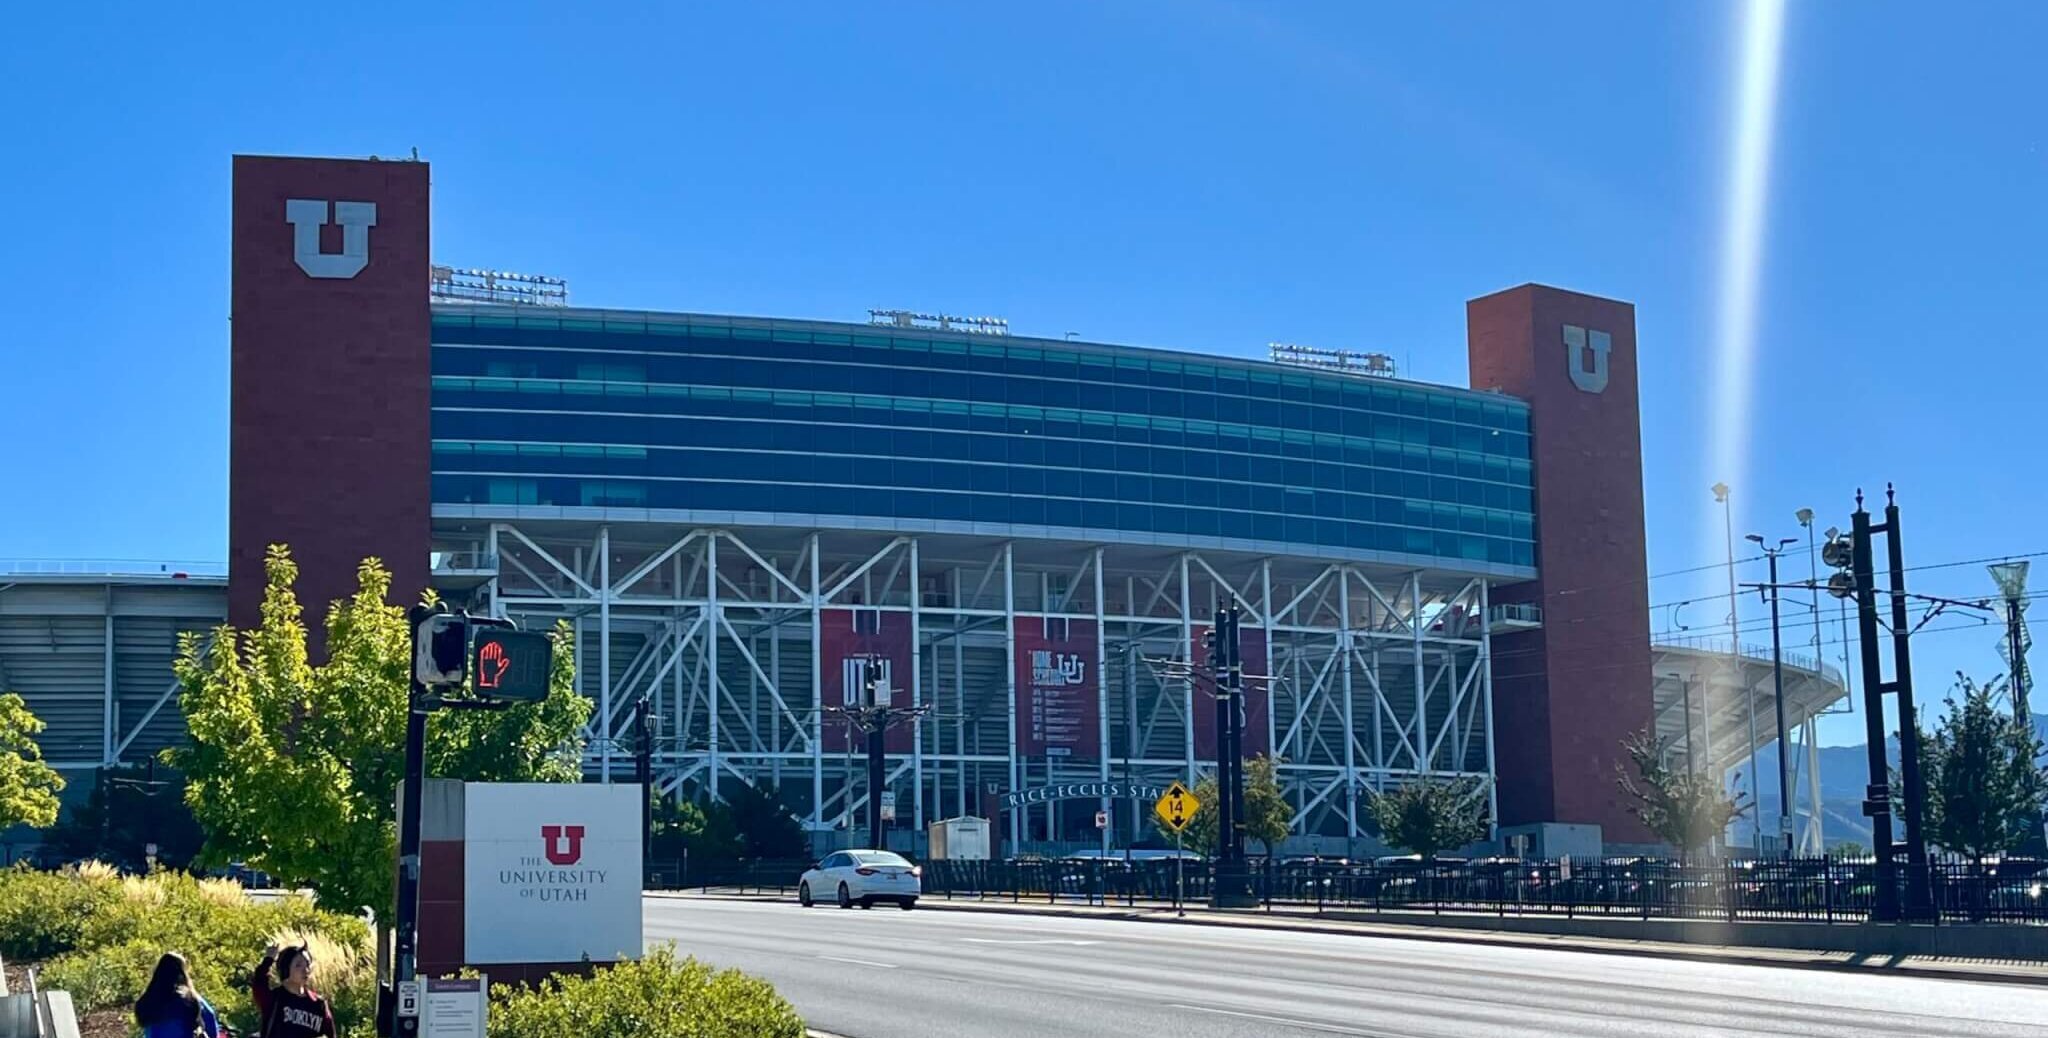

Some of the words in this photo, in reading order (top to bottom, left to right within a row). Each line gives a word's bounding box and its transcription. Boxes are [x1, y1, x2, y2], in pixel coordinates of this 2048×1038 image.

[286, 199, 377, 279] U
[1563, 324, 1611, 393] U
[1009, 783, 1119, 807] RICE-ECCLES
[1169, 800, 1183, 814] 14
[541, 825, 585, 865] U
[520, 857, 541, 866] THE
[500, 870, 607, 884] UNIVERSITY
[520, 888, 534, 898] OF
[540, 888, 587, 901] UTAH
